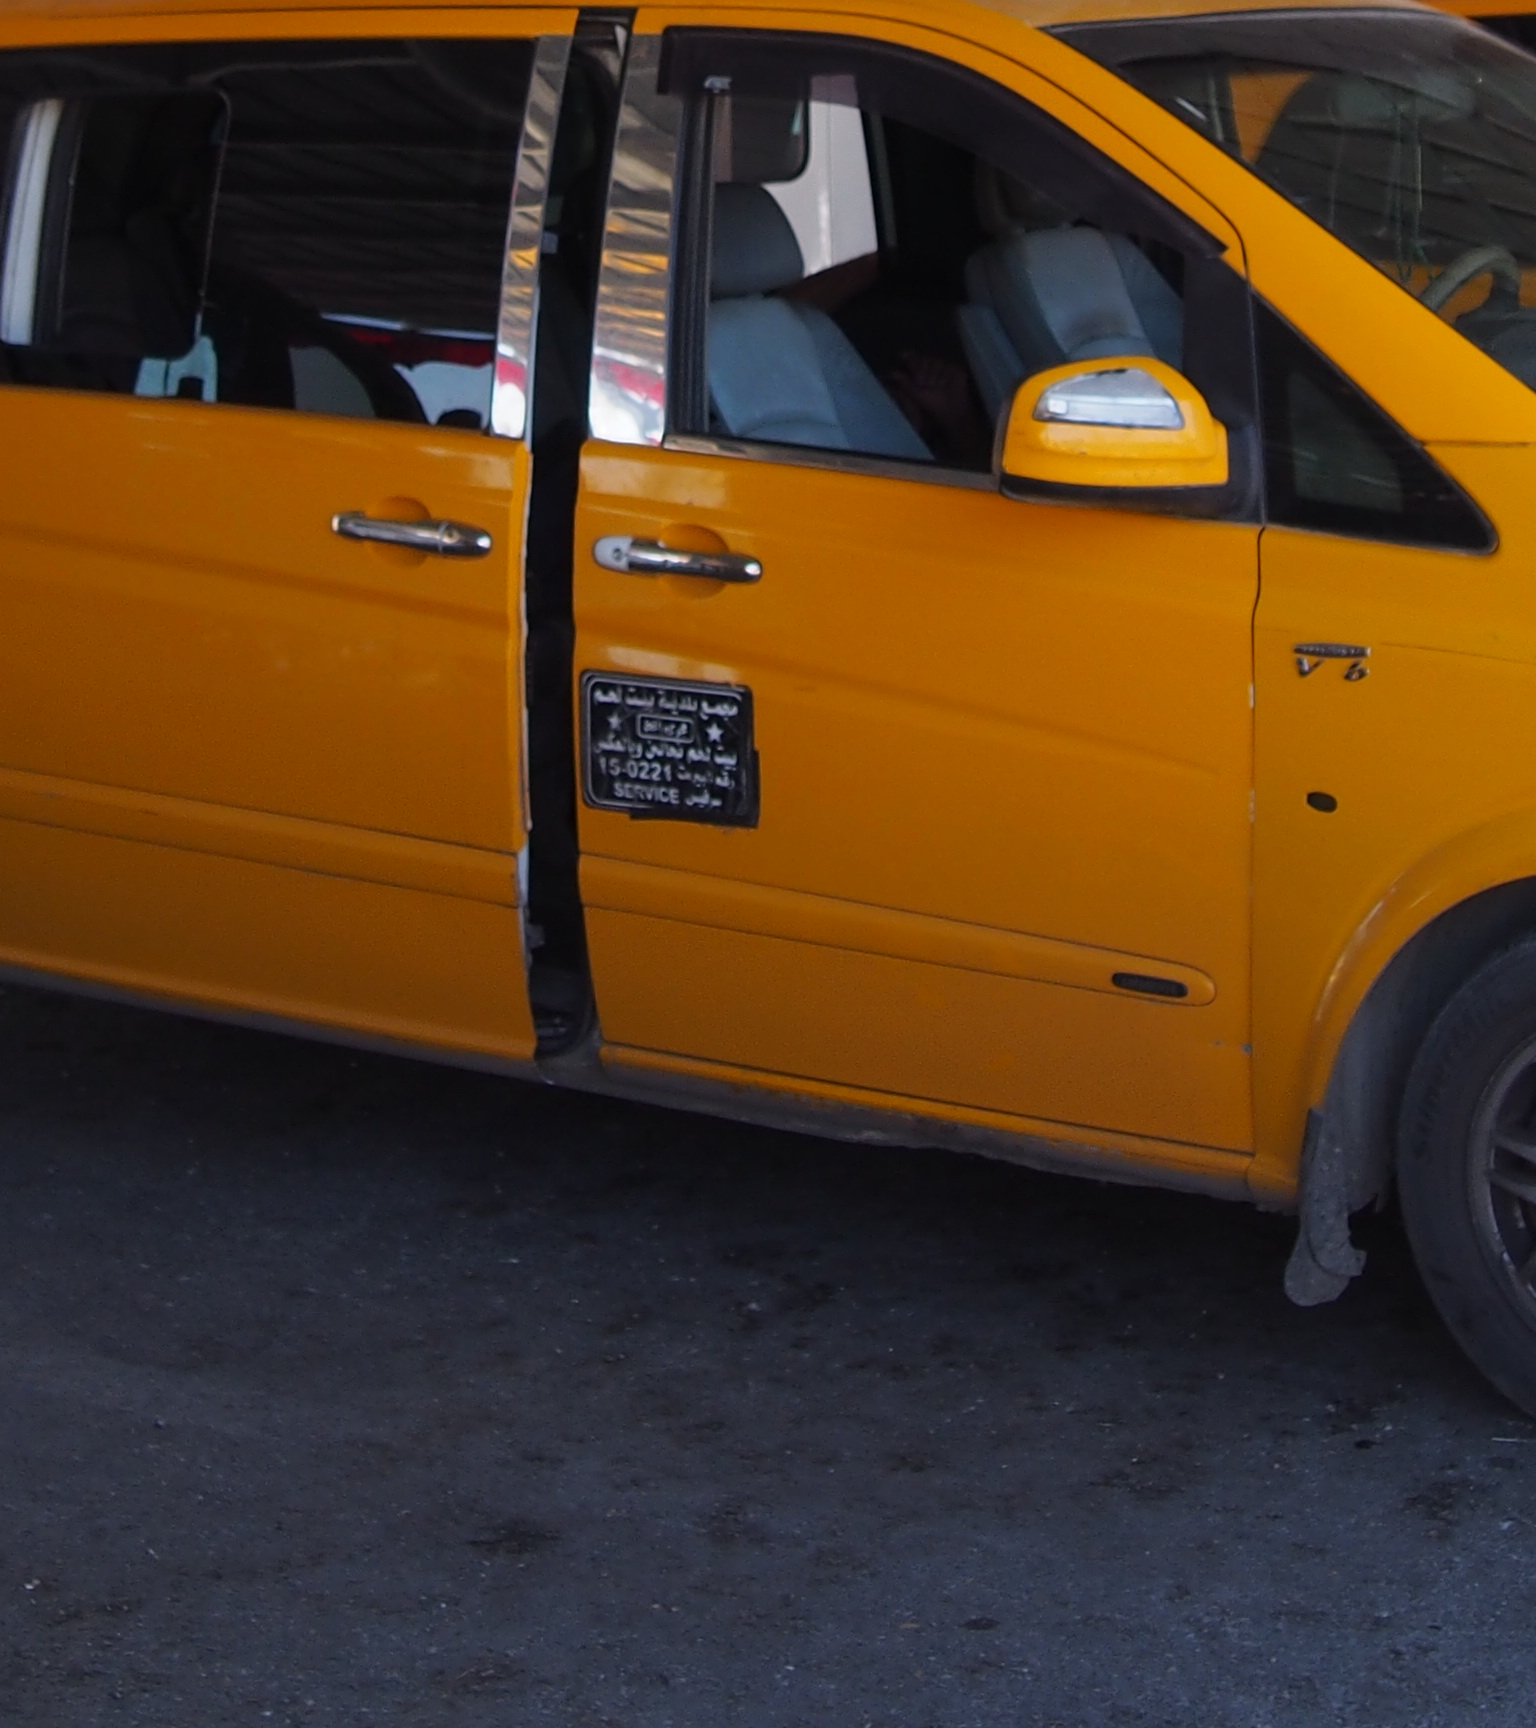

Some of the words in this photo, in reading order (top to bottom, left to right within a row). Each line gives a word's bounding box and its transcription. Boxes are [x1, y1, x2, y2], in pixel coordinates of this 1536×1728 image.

[593, 687, 623, 706] لحم
[658, 689, 698, 715] بلدية
[700, 700, 739, 720] مجمع
[599, 757, 673, 782] 15-0221
[614, 782, 680, 805] SERVICE
